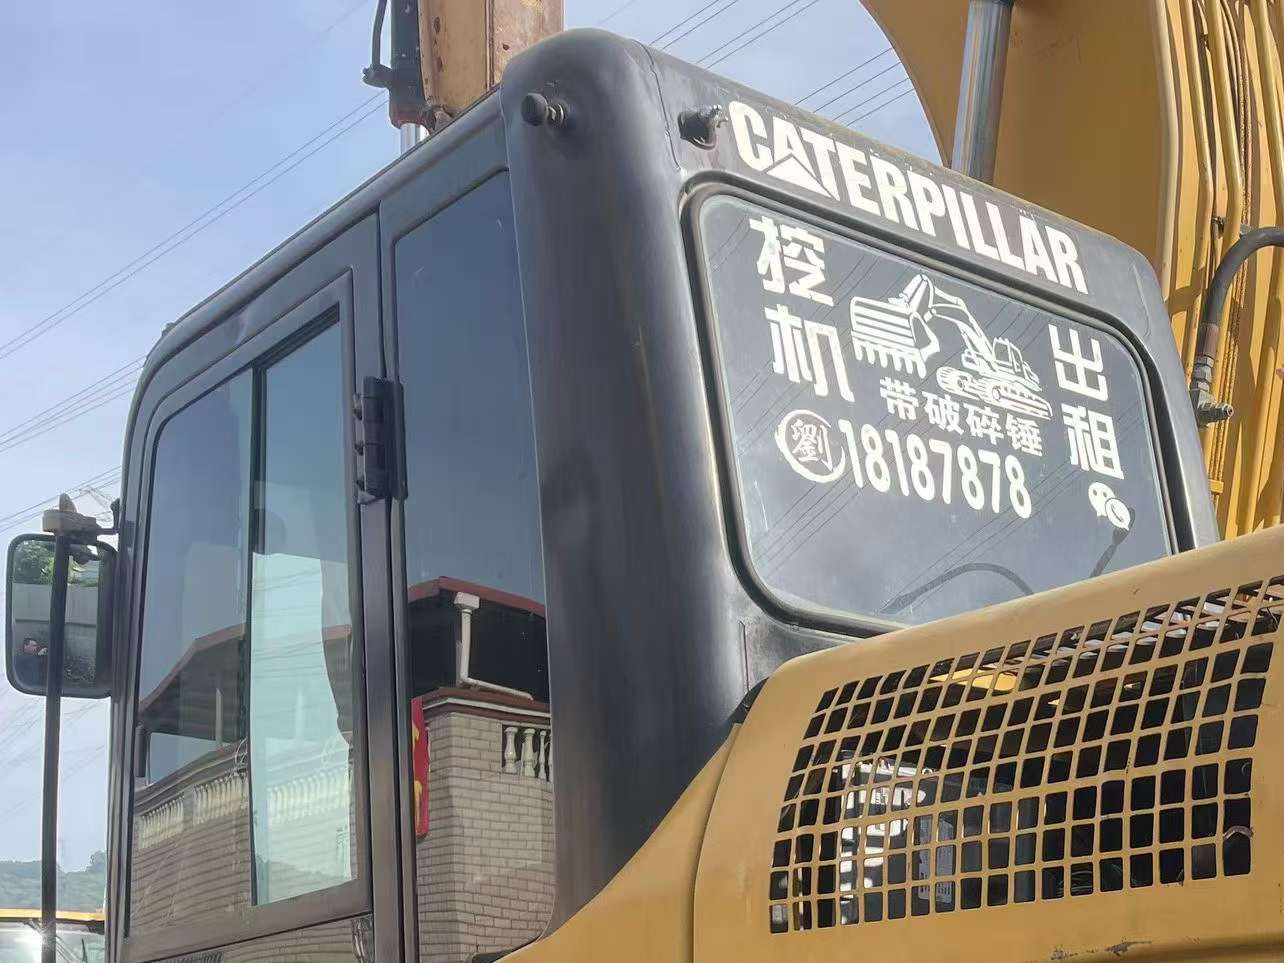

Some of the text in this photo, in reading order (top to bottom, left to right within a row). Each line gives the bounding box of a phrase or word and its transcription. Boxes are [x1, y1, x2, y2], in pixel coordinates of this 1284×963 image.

[728, 101, 1089, 294] CATERPILLAR
[750, 217, 855, 402] 挖机
[838, 419, 1032, 519] 18187878
[879, 376, 1043, 457] 带破碎锤
[1048, 323, 1125, 480] 出租
